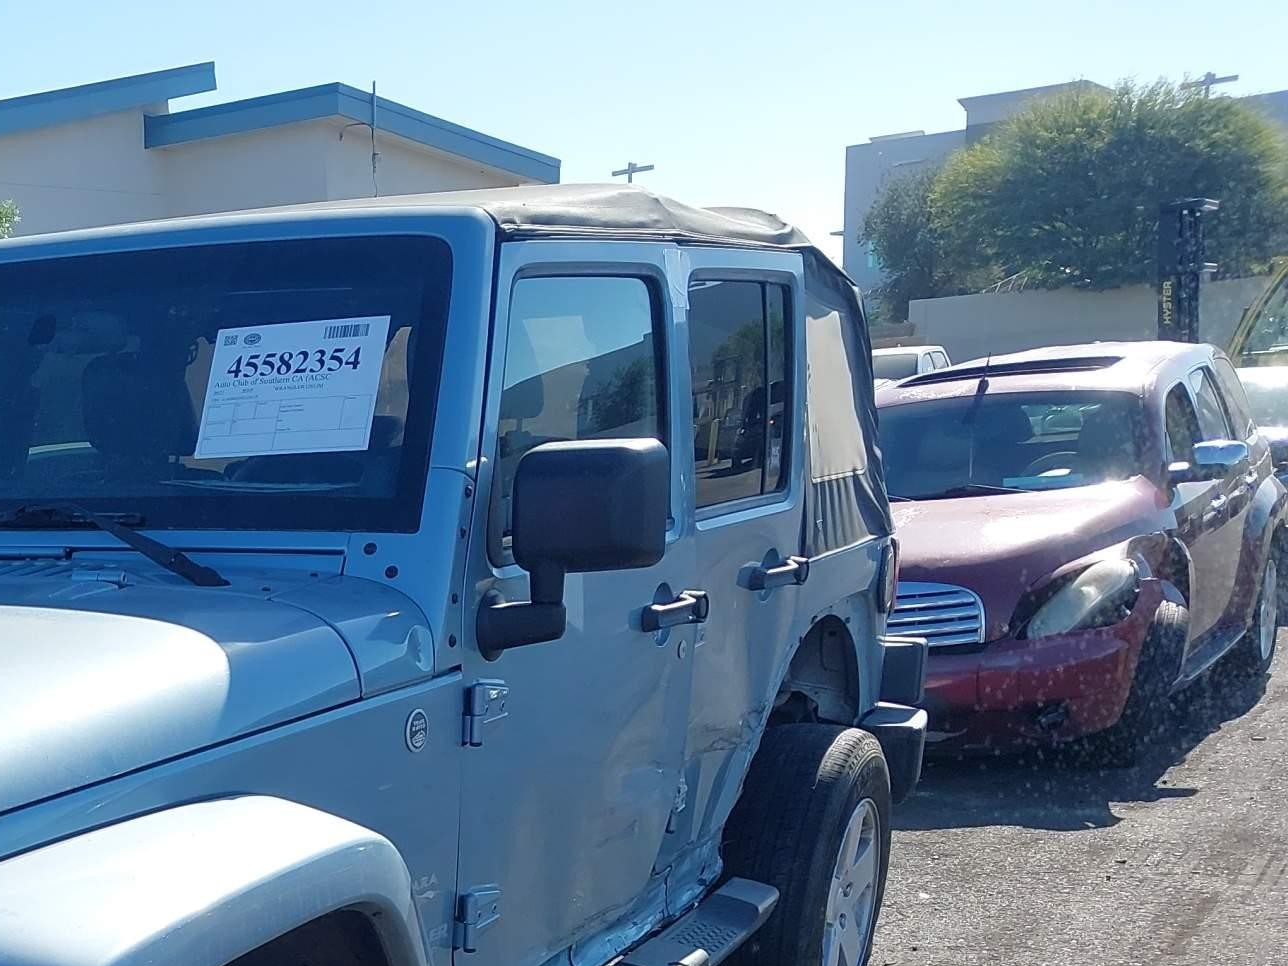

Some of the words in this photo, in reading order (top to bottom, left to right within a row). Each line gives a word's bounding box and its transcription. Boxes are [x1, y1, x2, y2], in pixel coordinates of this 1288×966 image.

[1162, 281, 1172, 324] HYSTER
[227, 346, 362, 378] 45582354
[214, 381, 231, 389] Auto
[232, 379, 248, 387] Club
[260, 376, 290, 385] Southern
